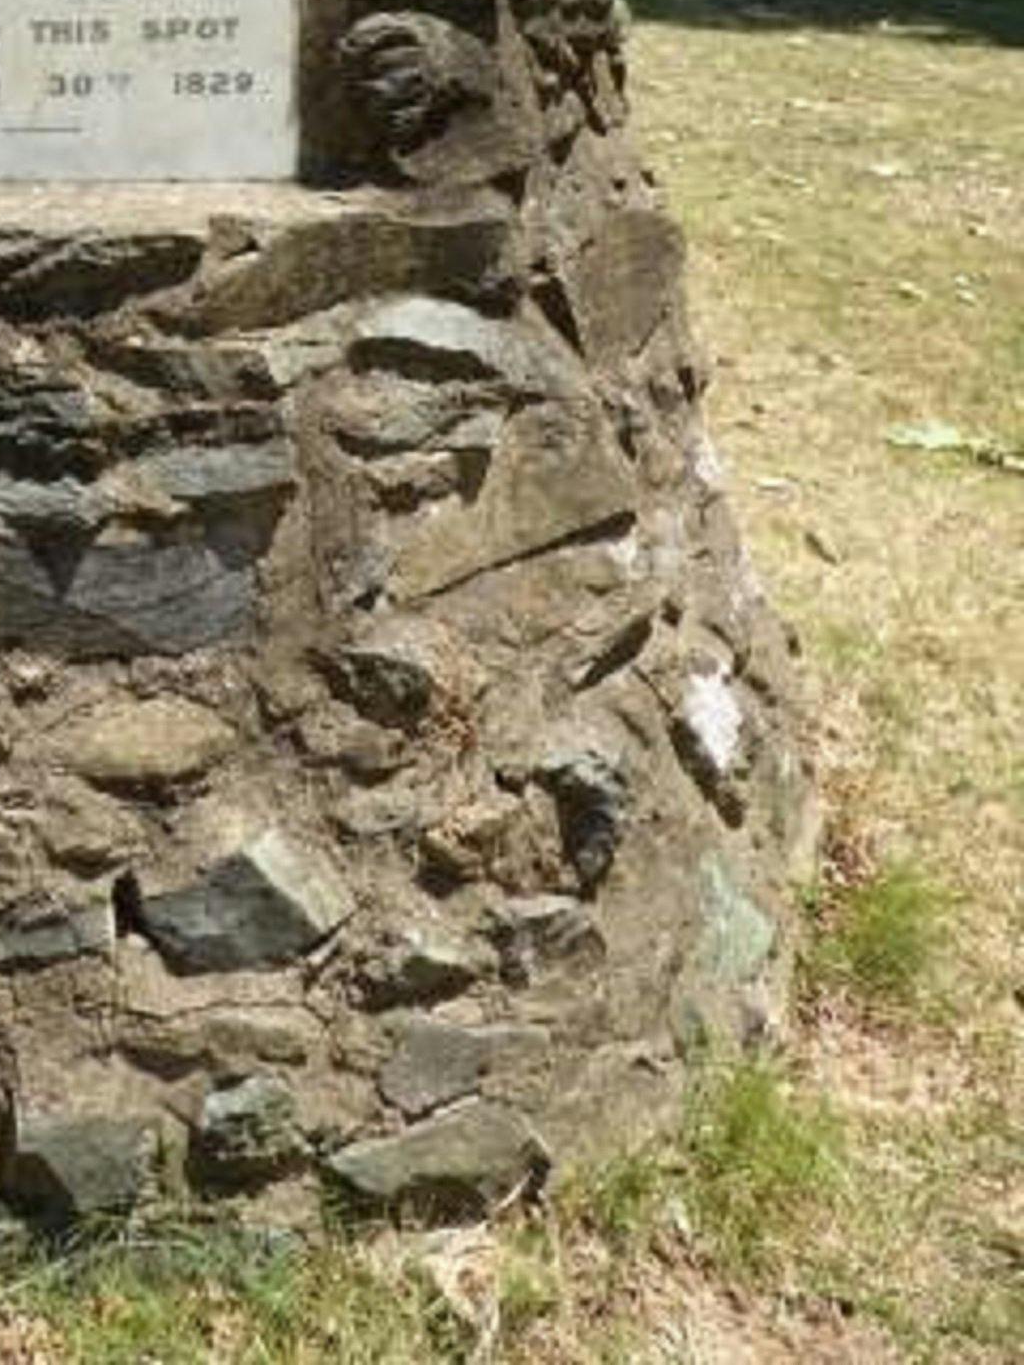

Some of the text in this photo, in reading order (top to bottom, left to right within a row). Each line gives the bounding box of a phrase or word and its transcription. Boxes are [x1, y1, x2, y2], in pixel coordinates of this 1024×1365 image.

[29, 19, 111, 45] THIS
[142, 17, 239, 42] SPOT
[173, 71, 254, 96] 1829
